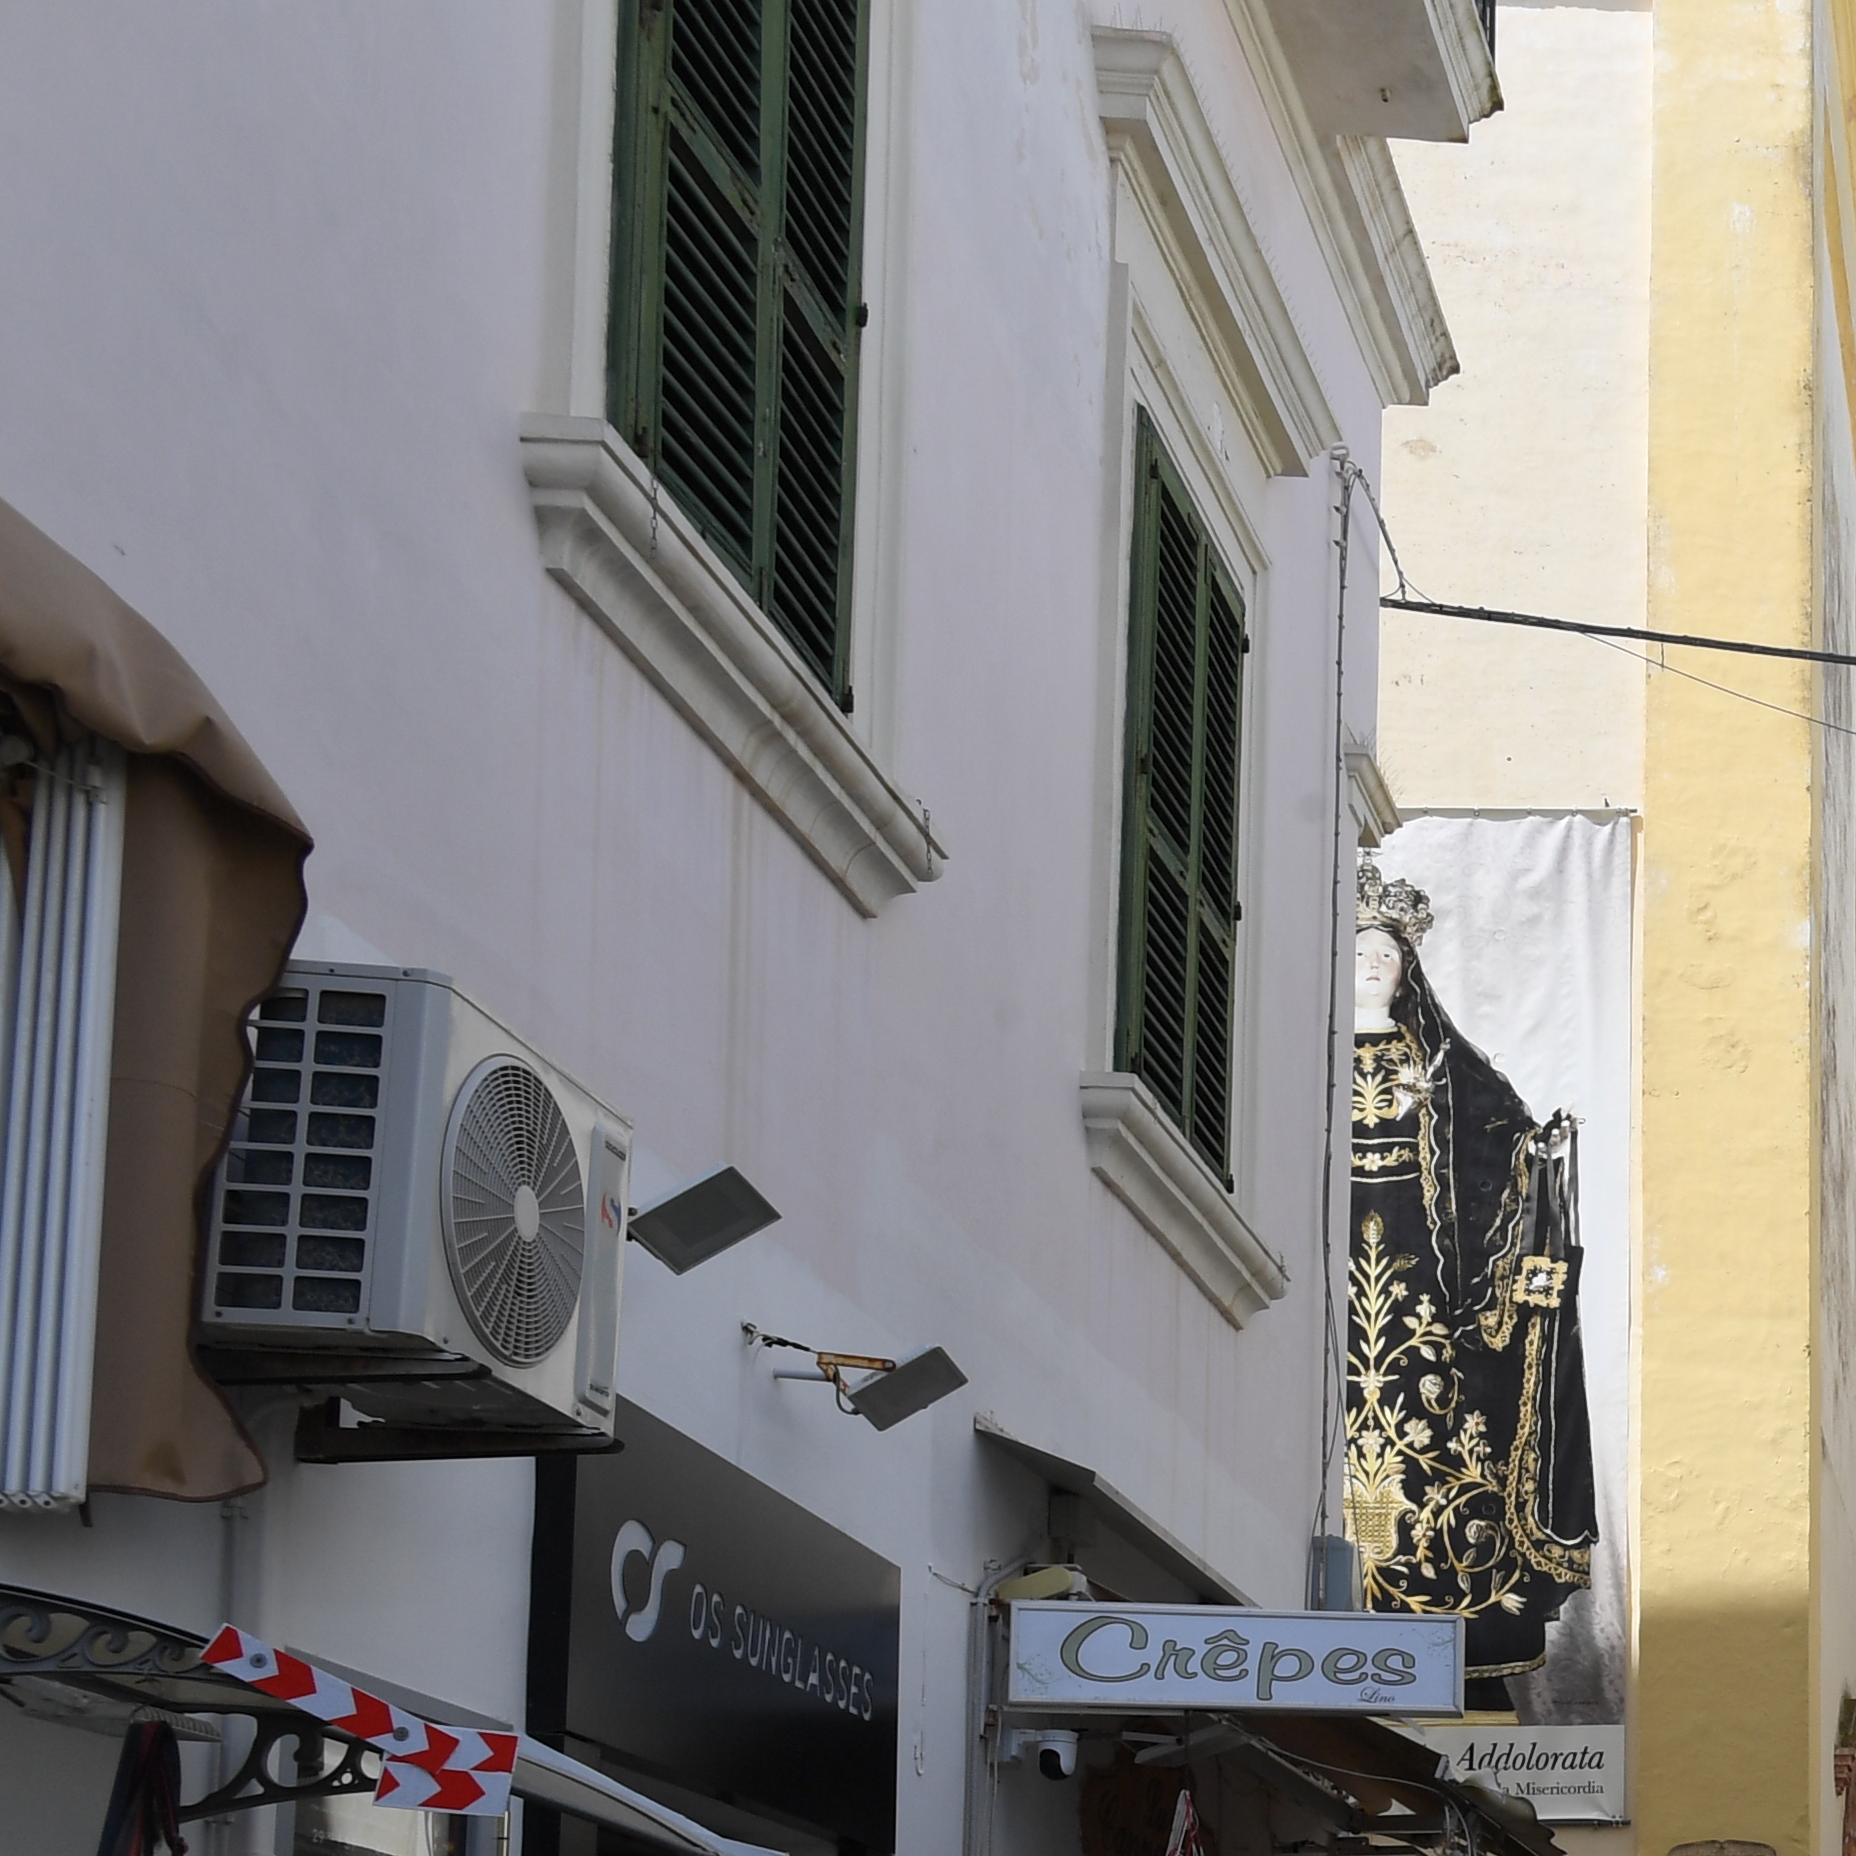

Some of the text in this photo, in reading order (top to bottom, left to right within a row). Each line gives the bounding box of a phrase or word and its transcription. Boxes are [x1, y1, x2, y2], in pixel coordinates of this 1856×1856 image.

[689, 1583, 874, 1723] OS SUNGLASSES
[1060, 1615, 1417, 1701] Crêpes
[1356, 1686, 1396, 1704] Lino
[1456, 1741, 1605, 1772] Addolorata
[1515, 1780, 1605, 1797] Misericordia
